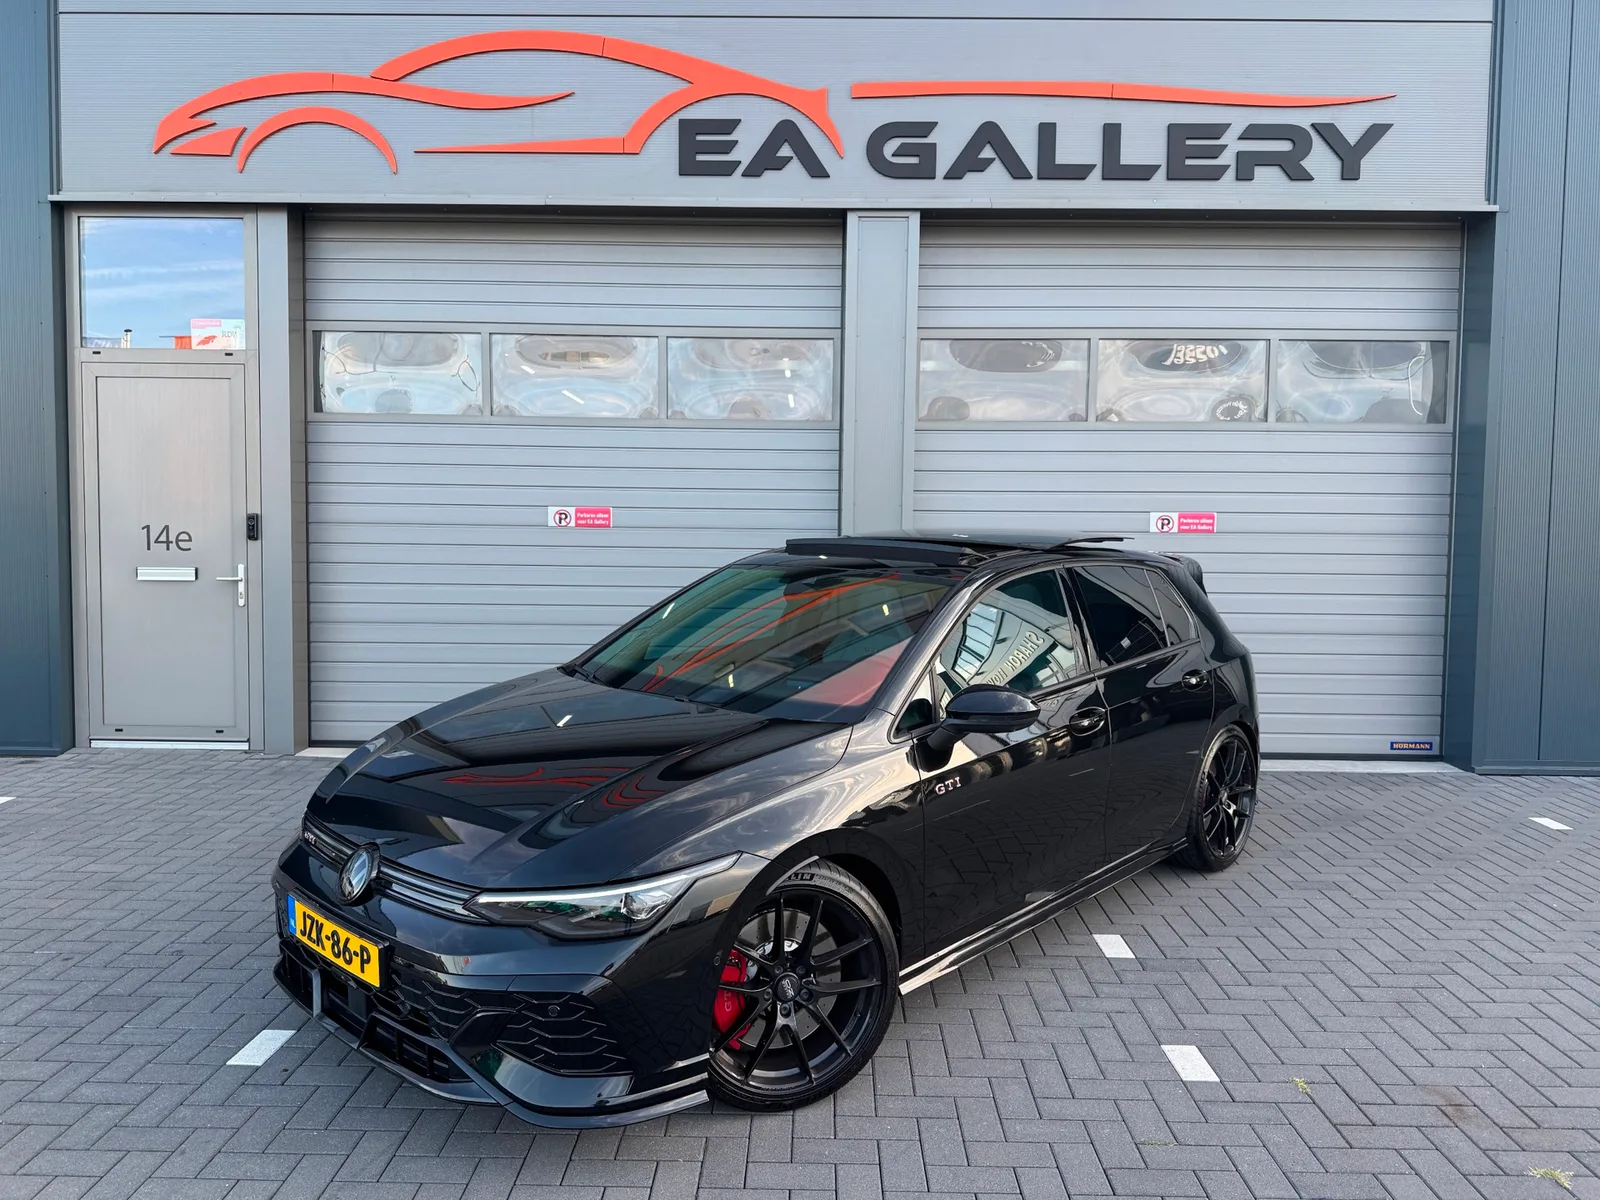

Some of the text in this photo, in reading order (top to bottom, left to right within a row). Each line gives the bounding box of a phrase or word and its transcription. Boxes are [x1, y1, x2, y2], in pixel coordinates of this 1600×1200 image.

[678, 118, 1395, 182] EA GALLERY
[141, 524, 193, 552] 14e
[935, 776, 962, 795] GTI
[300, 911, 371, 974] JZK-86-P
[723, 991, 733, 1012] GT
